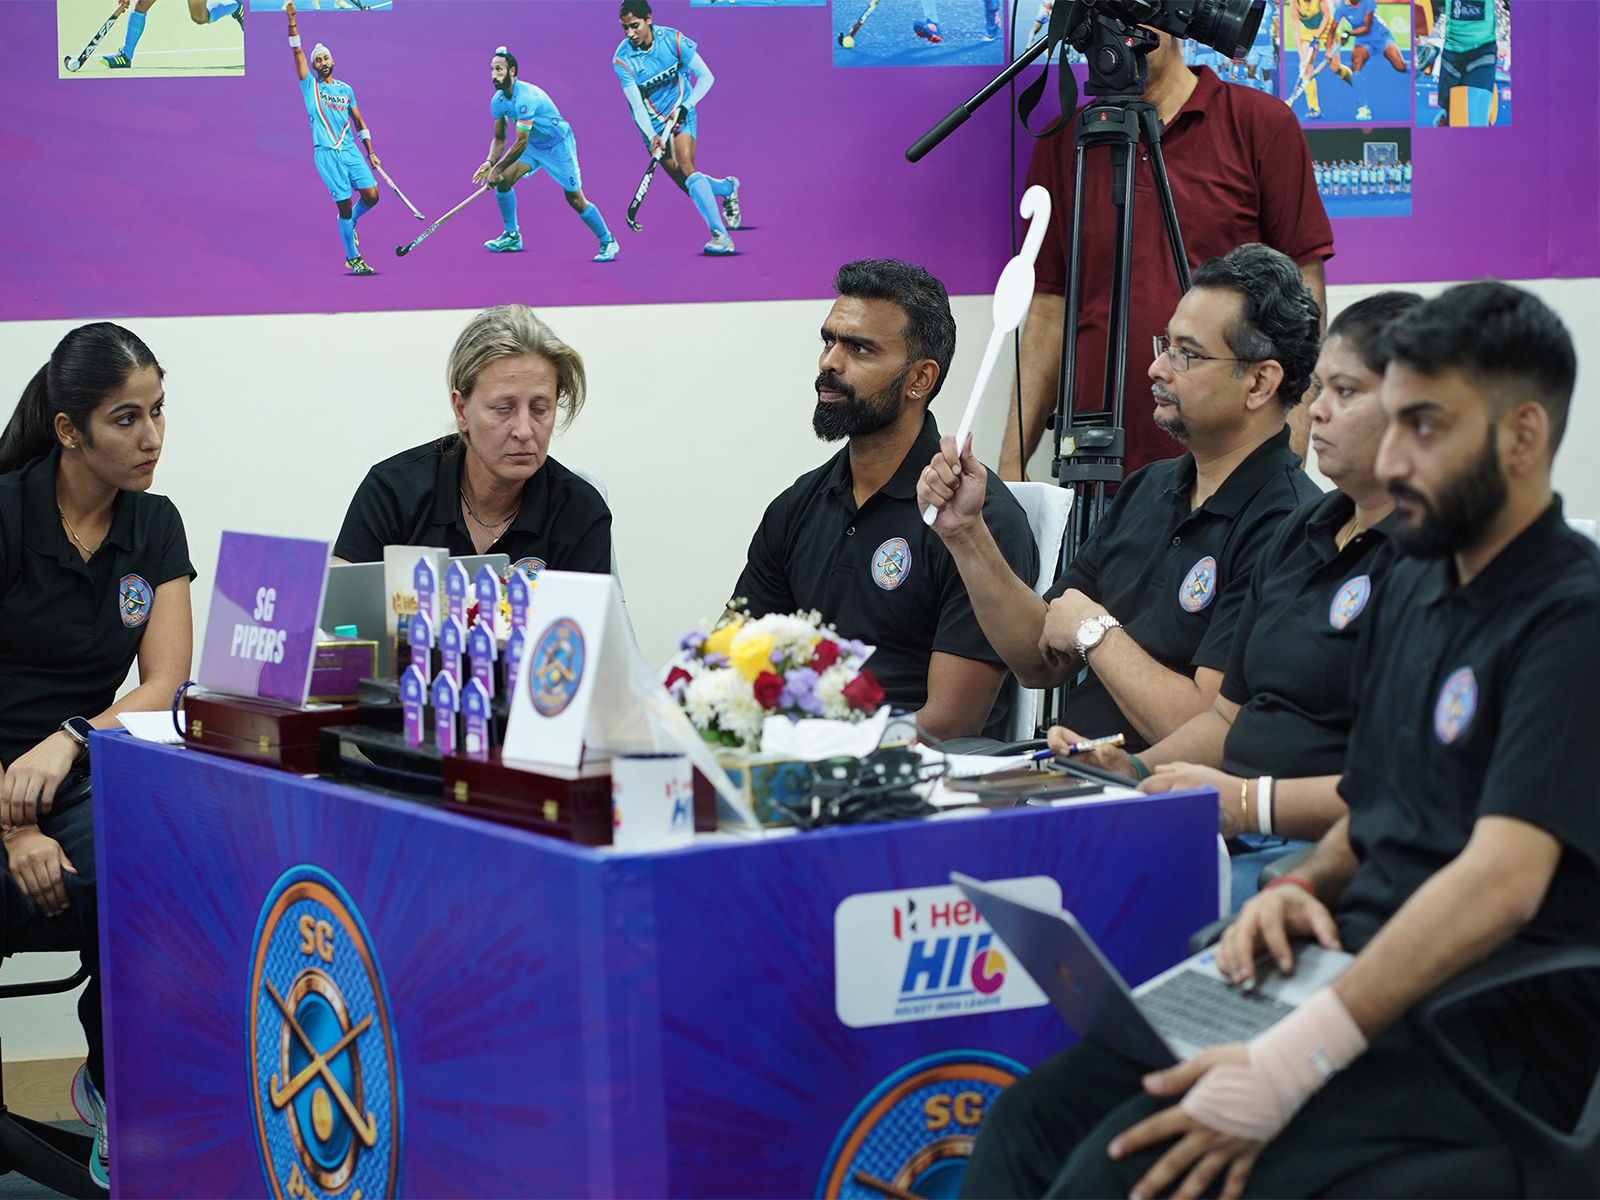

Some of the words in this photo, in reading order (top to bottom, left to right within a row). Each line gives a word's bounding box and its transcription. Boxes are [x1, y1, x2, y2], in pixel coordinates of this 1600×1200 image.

[84, 19, 117, 58] ALFA
[253, 586, 277, 622] SG
[230, 623, 286, 664] PIPERS
[299, 914, 334, 963] SG
[924, 1091, 984, 1130] SG
